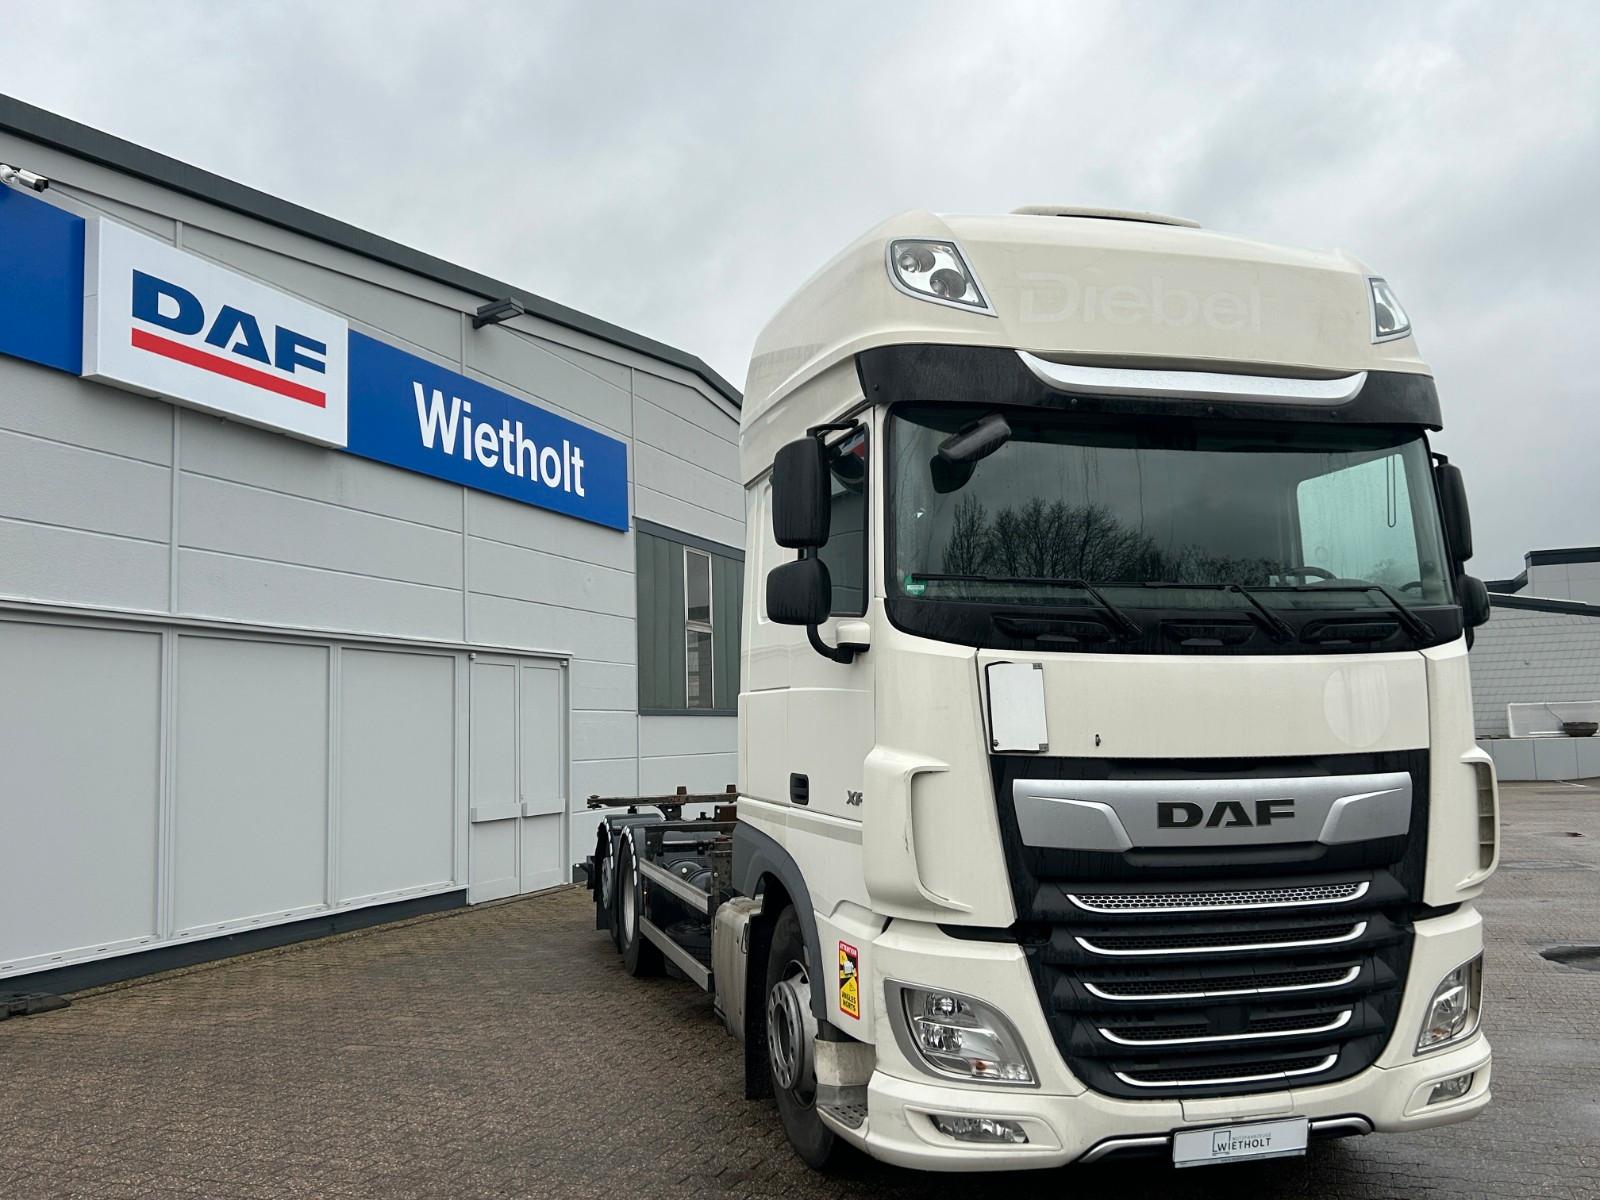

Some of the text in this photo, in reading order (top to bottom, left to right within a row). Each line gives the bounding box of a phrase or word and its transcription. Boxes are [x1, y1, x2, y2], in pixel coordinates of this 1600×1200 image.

[132, 268, 327, 375] DAF
[1017, 268, 1262, 335] Diebel
[412, 381, 586, 498] Wietholt
[1157, 799, 1295, 829] DAF
[1217, 1138, 1271, 1151] WIETHOLT
